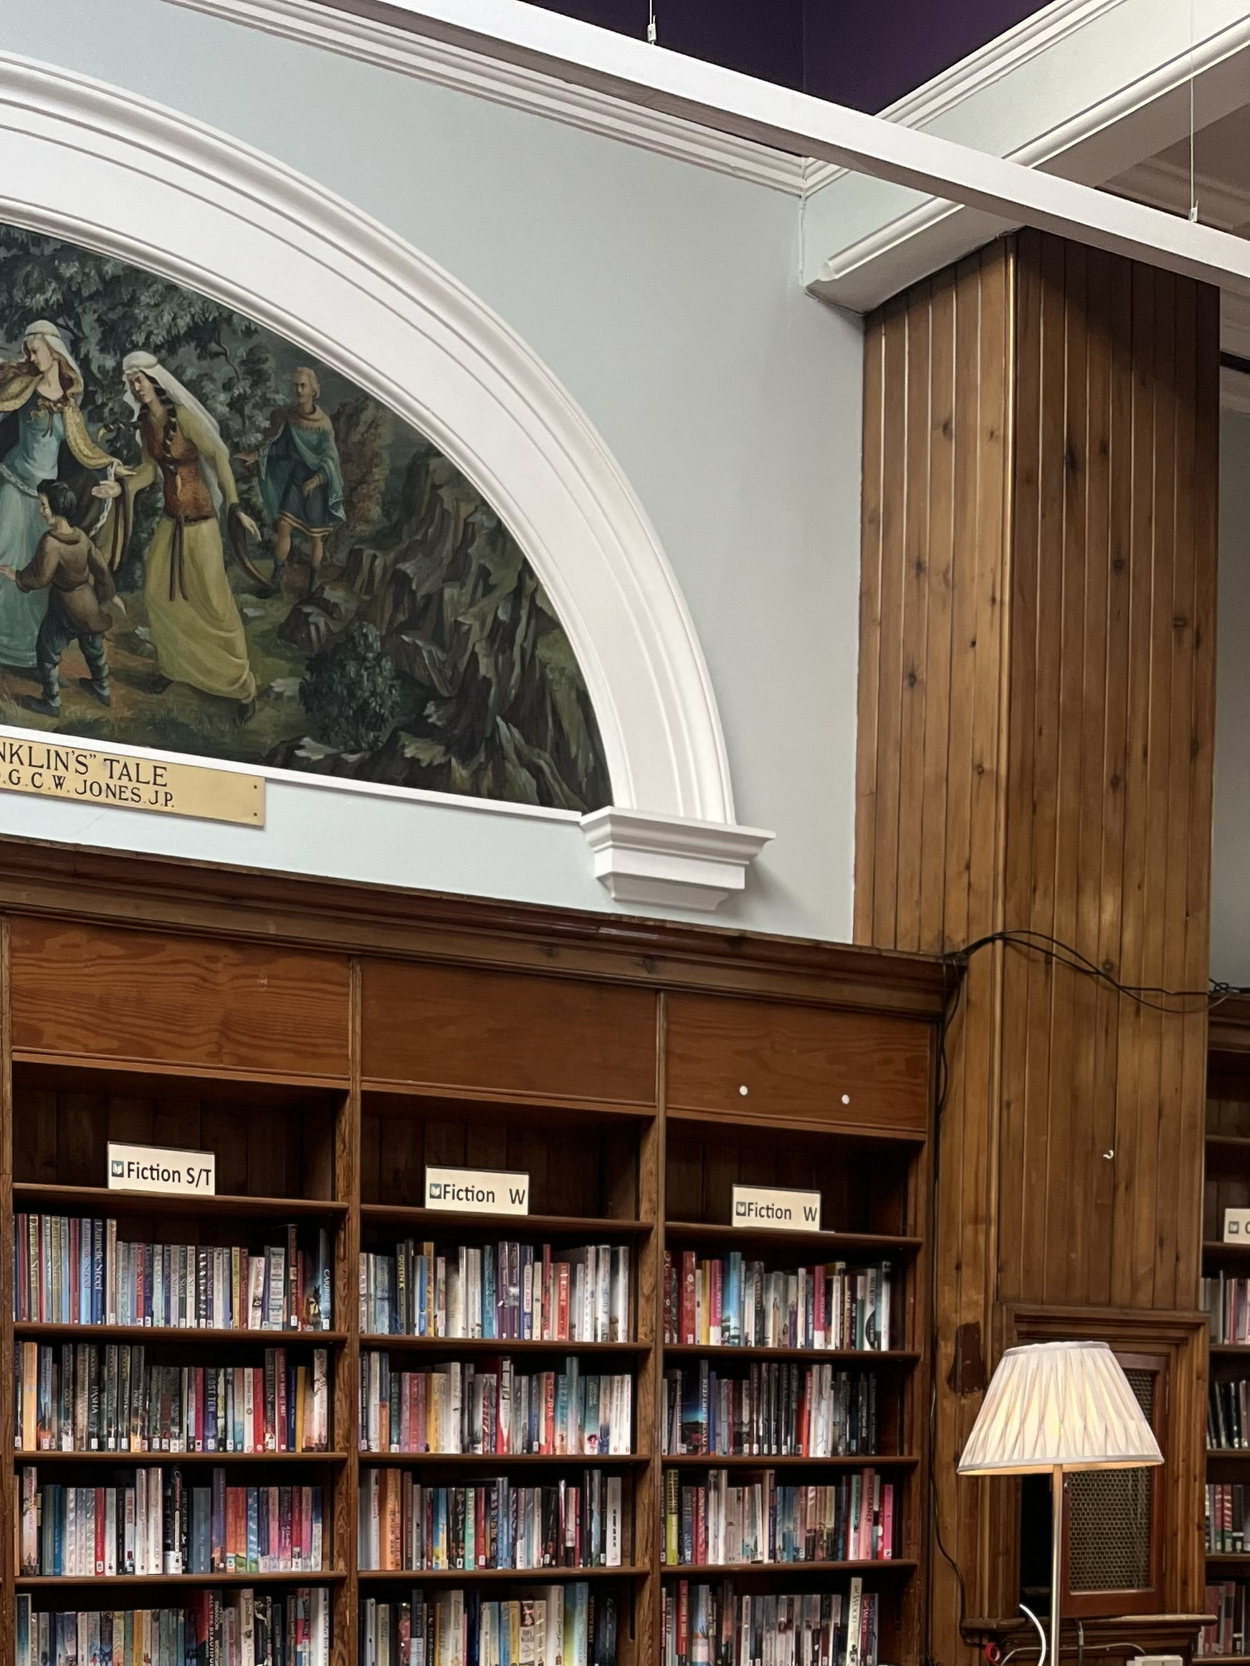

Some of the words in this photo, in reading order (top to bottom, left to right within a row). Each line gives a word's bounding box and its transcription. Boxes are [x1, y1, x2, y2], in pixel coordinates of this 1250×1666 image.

[104, 758, 168, 787] TALE
[128, 1162, 181, 1183] Fiction
[186, 1168, 212, 1188] S/T
[443, 1184, 495, 1203] Fiction
[509, 1188, 526, 1204] W
[748, 1202, 792, 1220] Fiction
[803, 1206, 817, 1222] W
